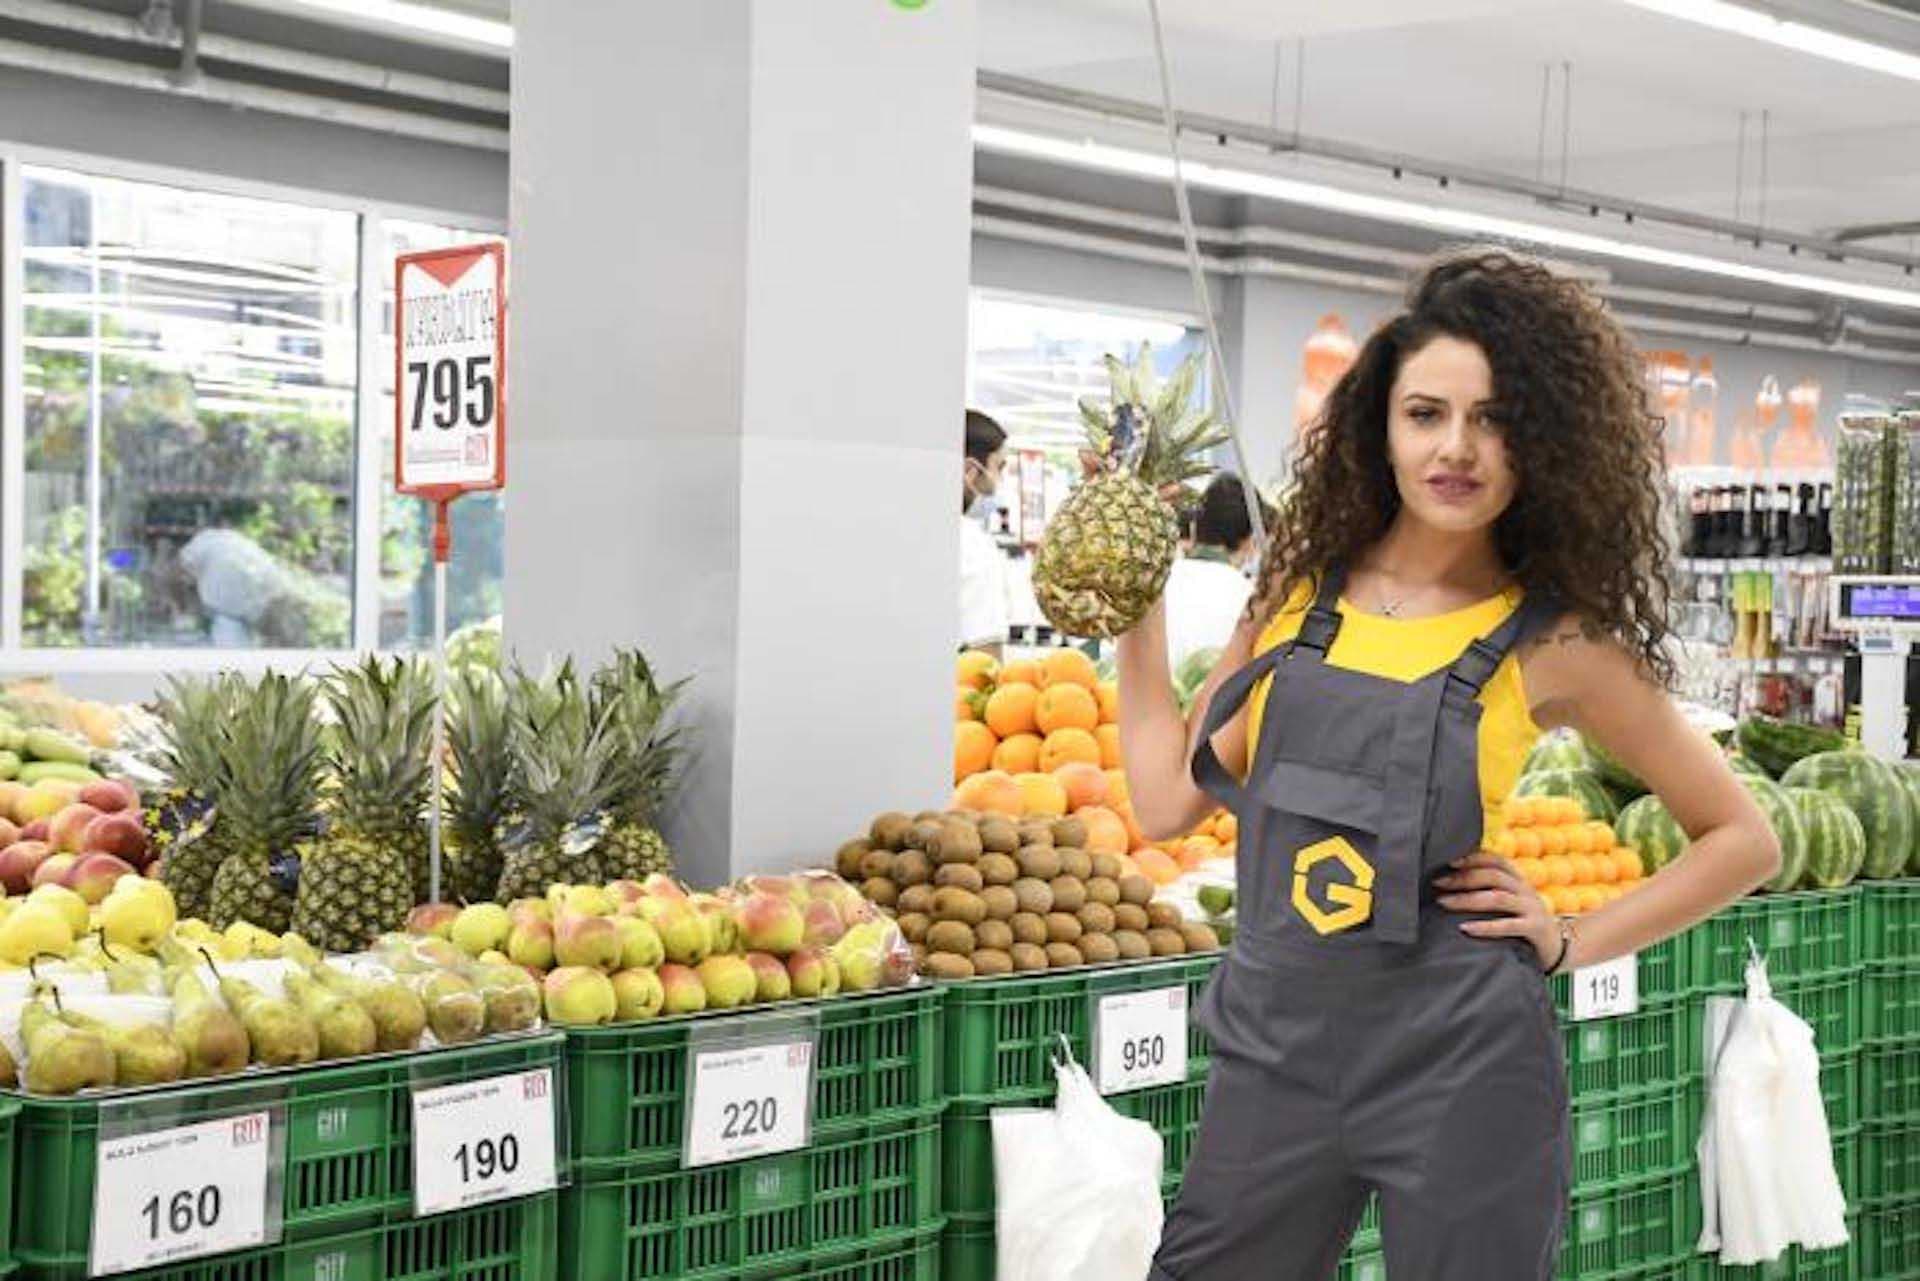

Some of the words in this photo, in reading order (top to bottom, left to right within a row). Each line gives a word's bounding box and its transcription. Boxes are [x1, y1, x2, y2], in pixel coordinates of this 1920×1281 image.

[408, 355, 494, 431] 795
[1291, 835, 1375, 935] G
[1589, 973, 1619, 1003] 119
[1123, 1035, 1164, 1071] 950
[722, 1096, 777, 1139] 220
[454, 1133, 519, 1182] 190
[142, 1184, 221, 1240] 160
